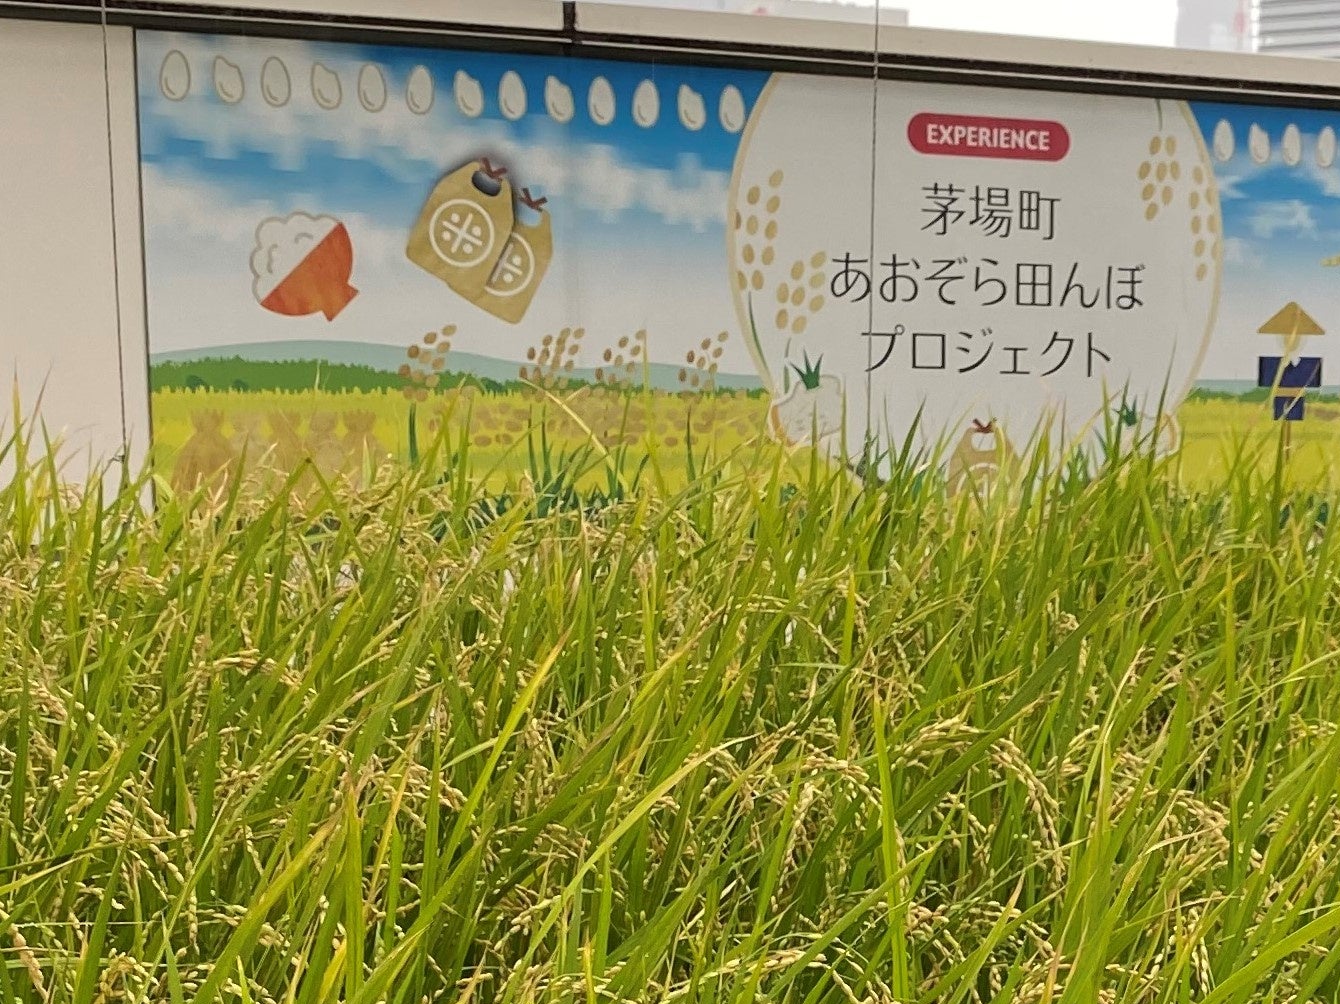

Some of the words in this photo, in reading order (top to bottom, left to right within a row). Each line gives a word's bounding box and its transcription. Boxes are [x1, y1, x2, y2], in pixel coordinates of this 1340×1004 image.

[926, 123, 1050, 151] EXPERIENCE
[921, 182, 1061, 240] 茅場町
[830, 252, 1146, 310] あおぞら田んぼ
[861, 324, 1111, 377] プロジェクト
